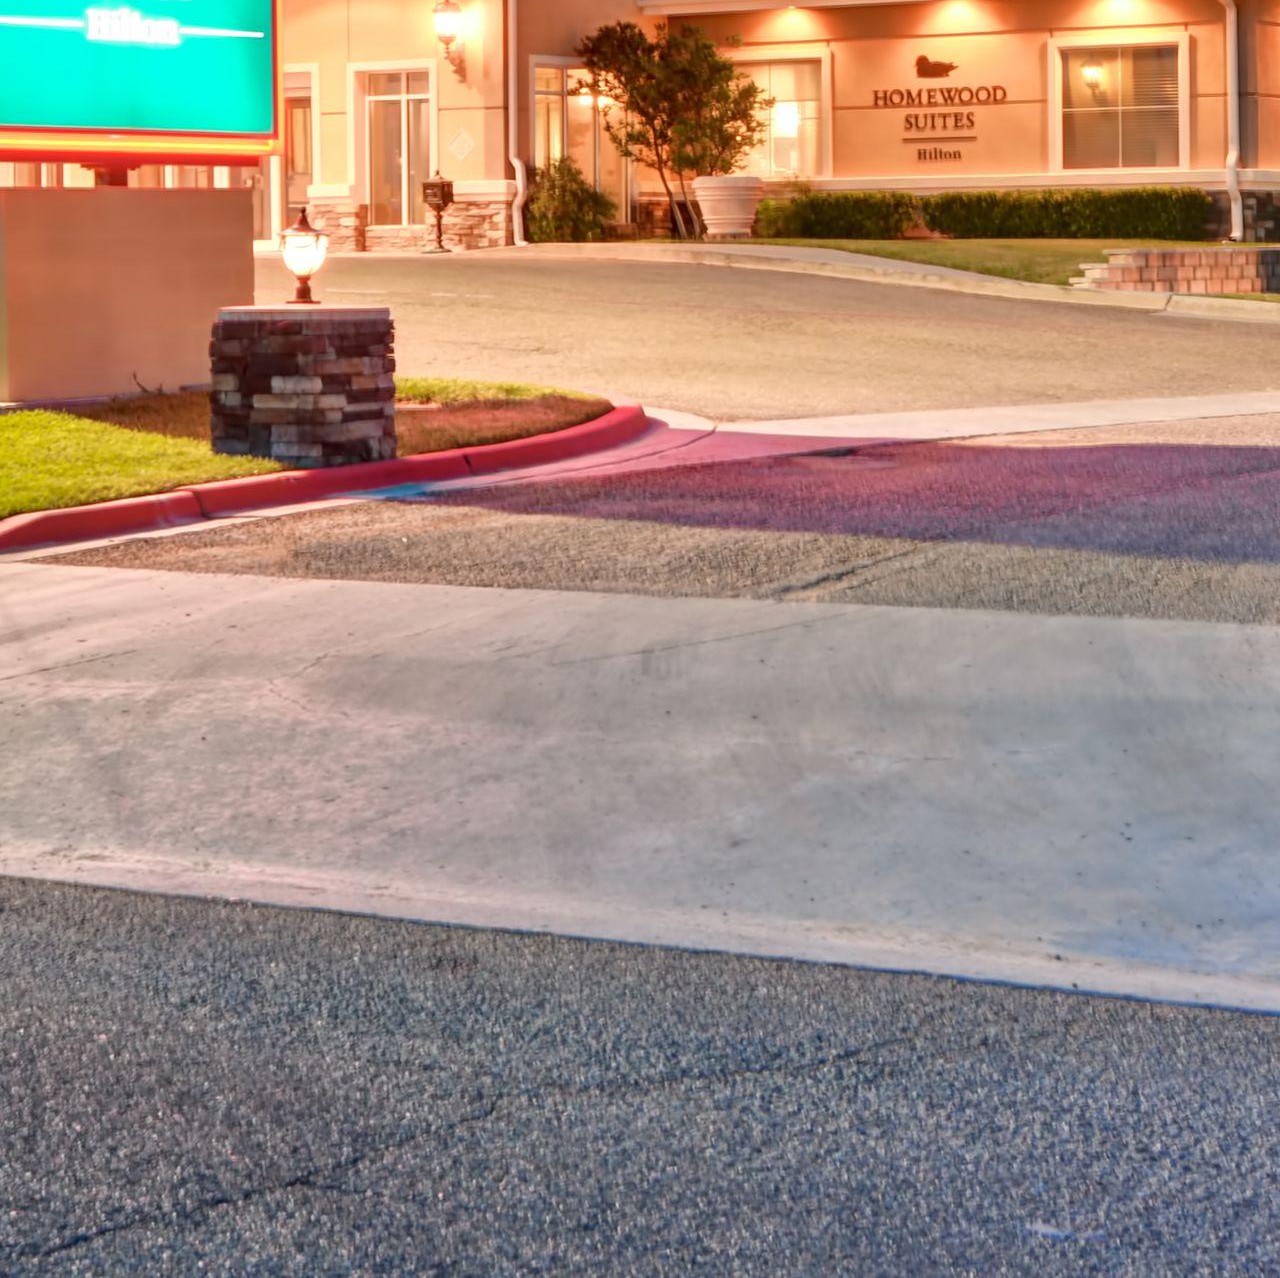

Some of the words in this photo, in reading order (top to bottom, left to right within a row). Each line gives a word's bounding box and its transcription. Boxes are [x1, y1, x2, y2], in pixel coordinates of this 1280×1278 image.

[873, 85, 1007, 107] HOMEWOOD
[904, 111, 976, 131] SUITES
[917, 147, 963, 162] Hilton
